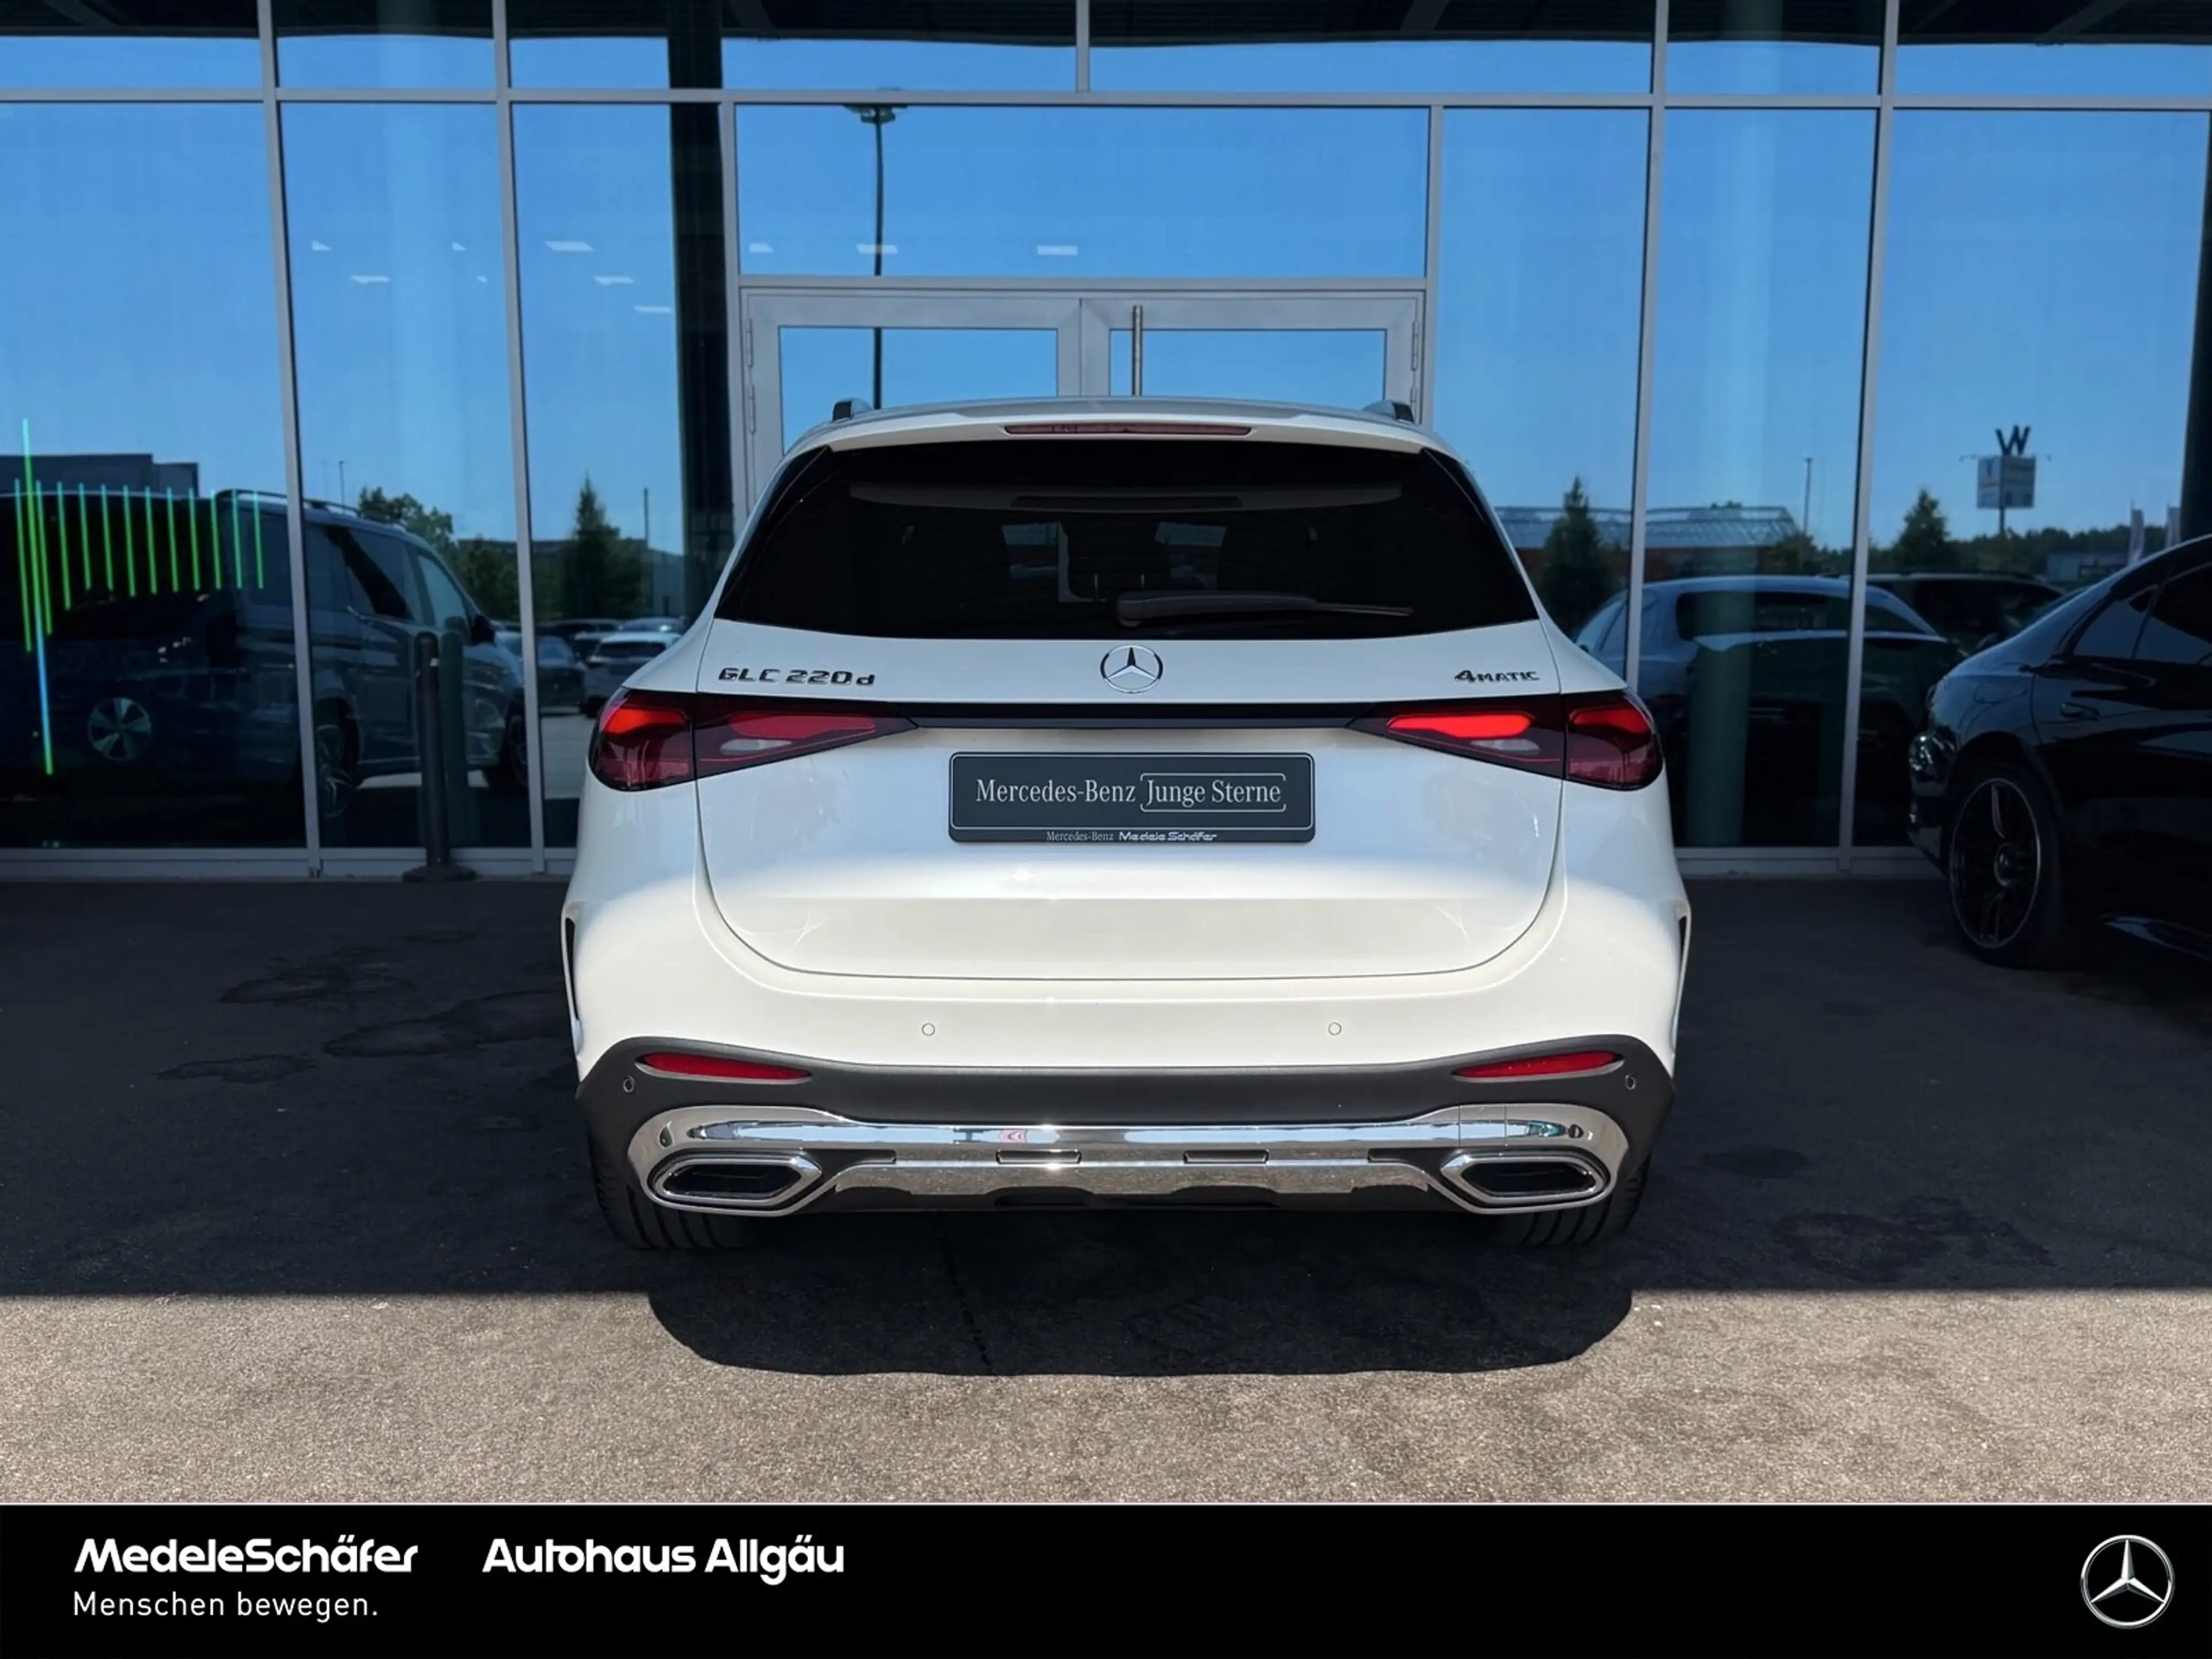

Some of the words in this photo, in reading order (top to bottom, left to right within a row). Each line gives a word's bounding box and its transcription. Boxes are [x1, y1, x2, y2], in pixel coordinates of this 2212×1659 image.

[718, 668, 781, 683] GLC
[1454, 670, 1540, 683] 4MATIC
[975, 778, 1136, 803] Mercedes-Benz
[1146, 779, 1206, 808] Junge
[1212, 779, 1282, 804] Sterne
[1046, 831, 1115, 842] Mercedes-Benz
